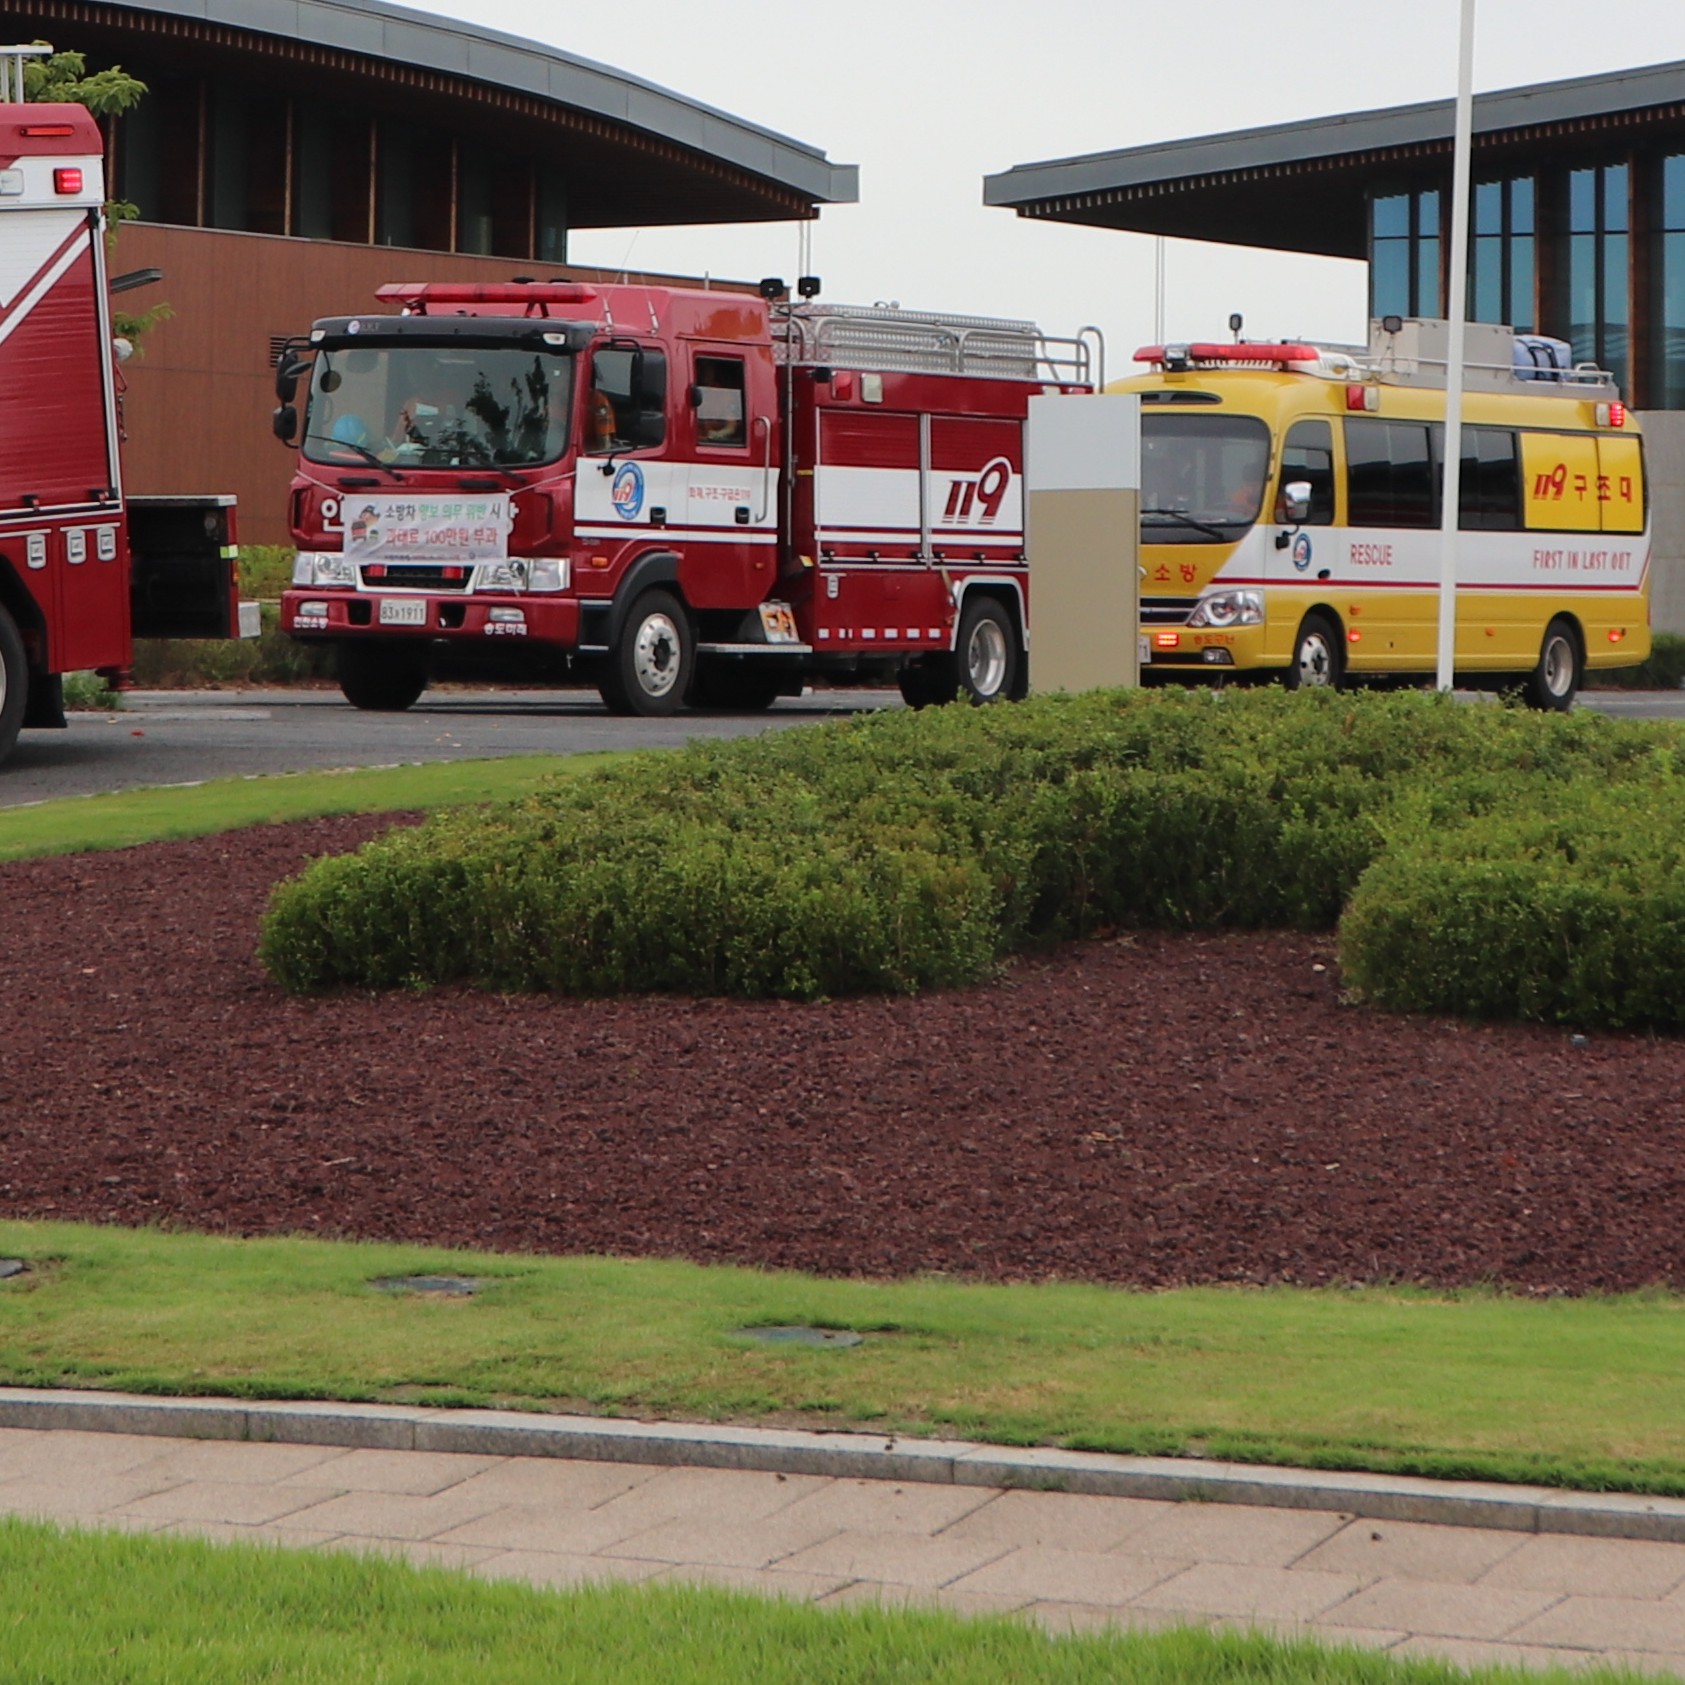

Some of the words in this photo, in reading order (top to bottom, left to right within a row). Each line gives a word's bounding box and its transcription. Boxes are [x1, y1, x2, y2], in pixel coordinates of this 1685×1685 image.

[942, 461, 1010, 525] 119
[1532, 463, 1567, 501] 119
[385, 503, 416, 522] 소방차
[1350, 543, 1393, 566] RESCUE
[1533, 549, 1564, 569] FIRST
[1567, 550, 1578, 569] IN
[1582, 551, 1609, 570] LAST
[1611, 552, 1632, 571] OUT
[1154, 563, 1198, 583] 소방
[483, 621, 528, 637] 송도미래
